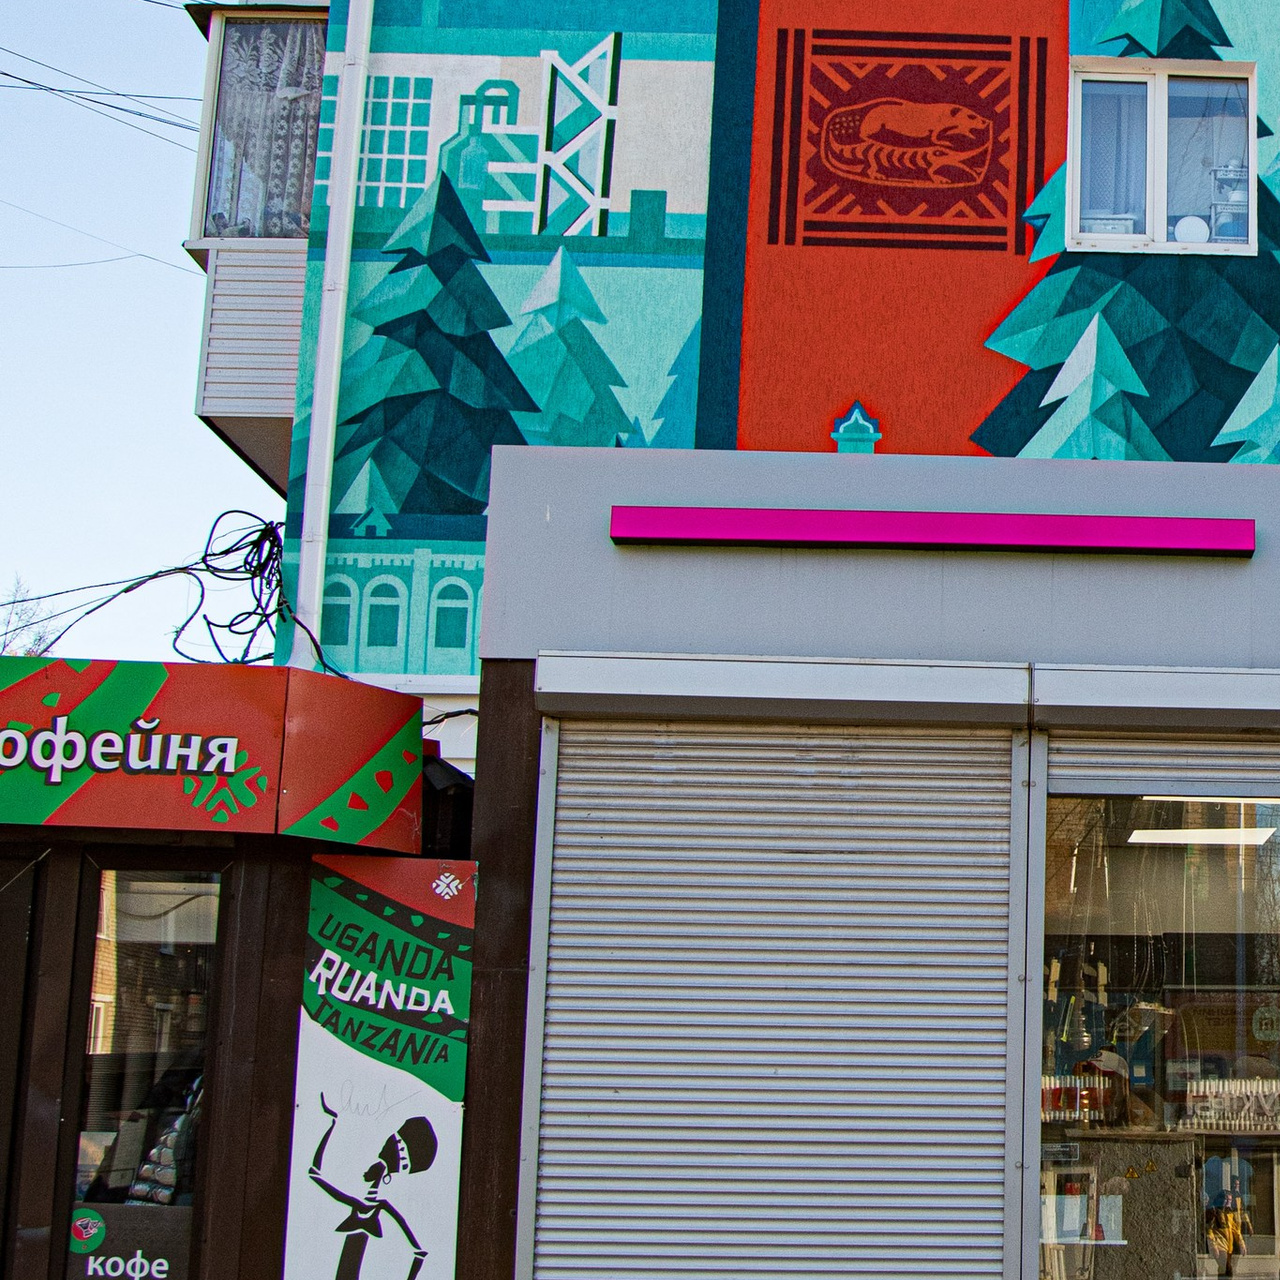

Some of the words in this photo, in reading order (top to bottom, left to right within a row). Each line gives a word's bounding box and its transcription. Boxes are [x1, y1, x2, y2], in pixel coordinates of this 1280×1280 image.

[0, 716, 239, 783] офейня
[317, 913, 455, 982] UGANDA
[308, 948, 456, 1016] RUANDA
[311, 996, 450, 1066] TANZANIA
